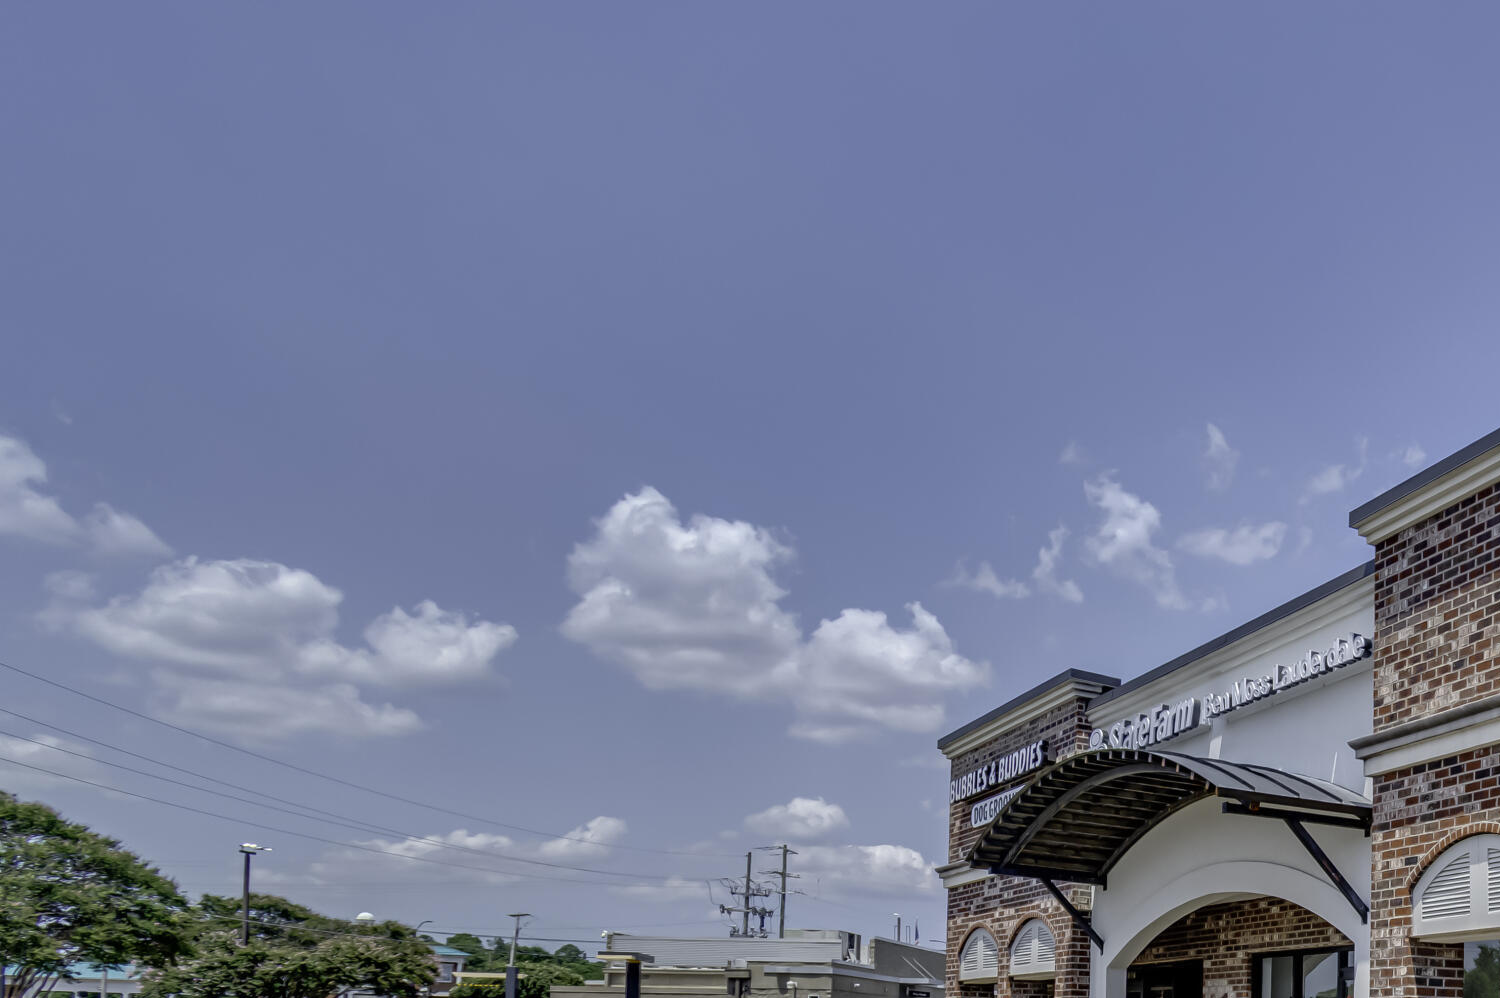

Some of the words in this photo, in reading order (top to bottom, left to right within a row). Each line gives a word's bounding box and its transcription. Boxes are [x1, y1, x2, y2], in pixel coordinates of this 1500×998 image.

[1202, 690, 1232, 718] Ben
[1232, 675, 1272, 708] Moss
[1272, 632, 1367, 691] Lauderdale
[950, 764, 988, 804] BUBBLES
[988, 760, 996, 786] &
[997, 740, 1043, 783] BUDDIES
[973, 803, 988, 825] DOG
